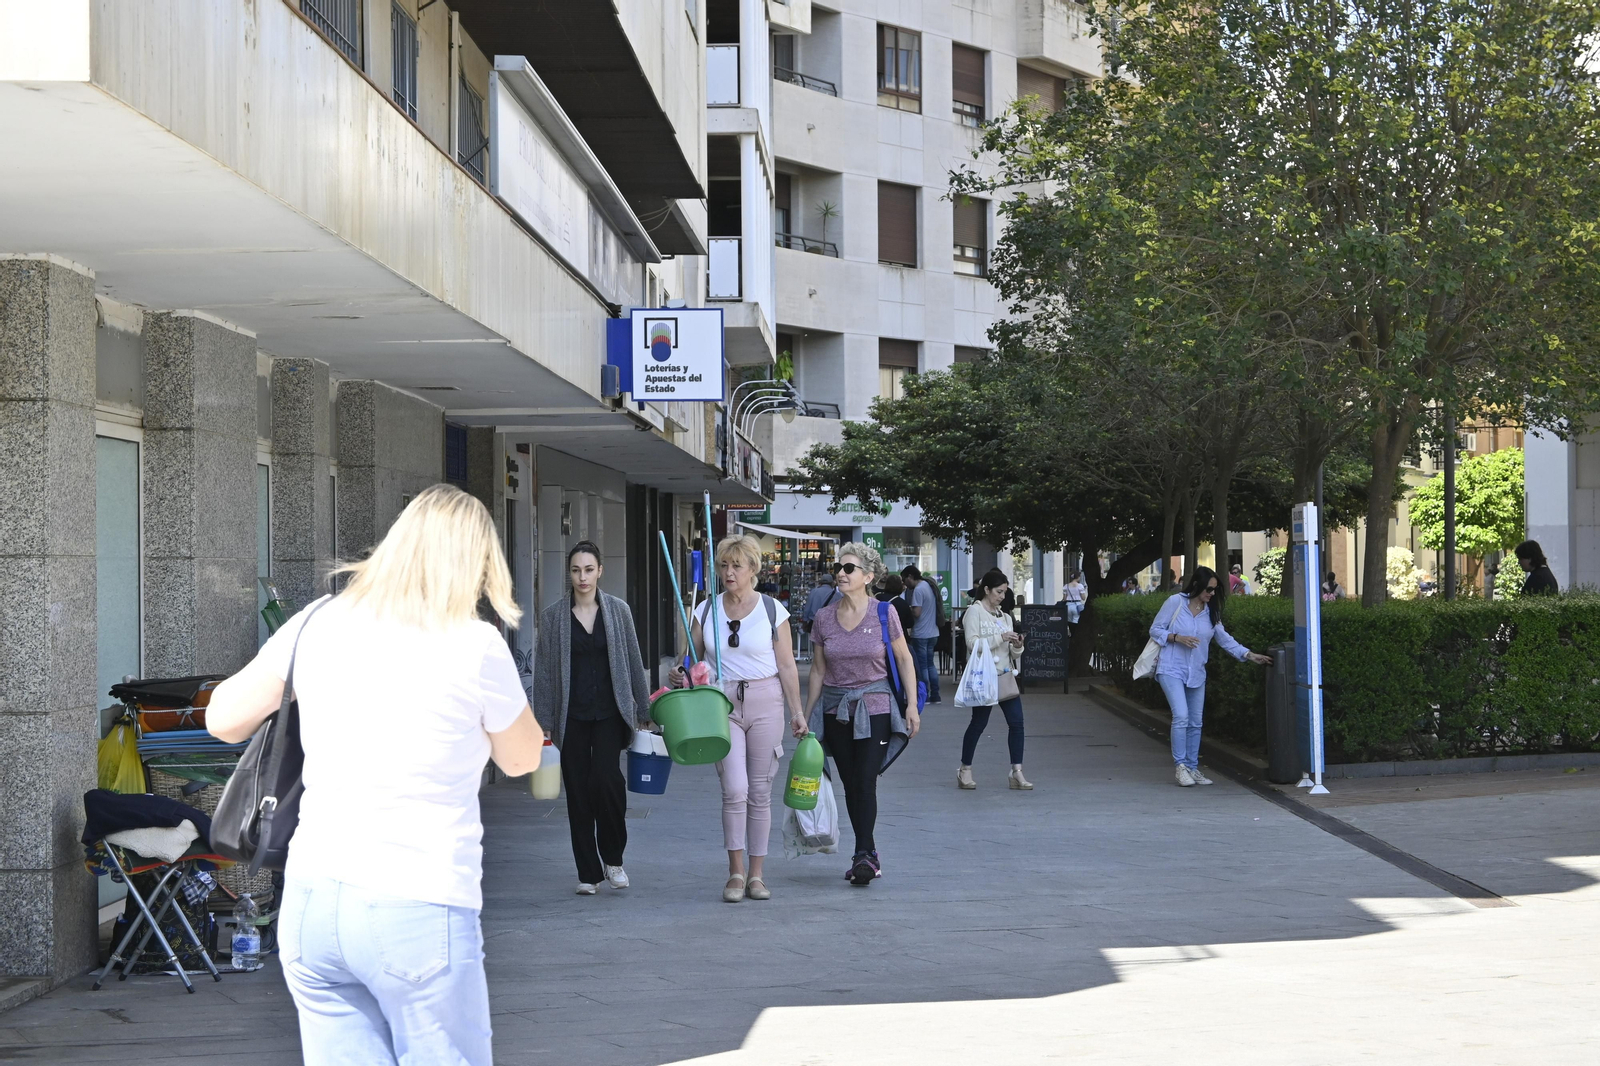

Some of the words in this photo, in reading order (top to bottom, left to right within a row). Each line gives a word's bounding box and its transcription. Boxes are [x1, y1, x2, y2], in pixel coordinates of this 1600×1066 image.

[644, 364, 681, 373] Loterías
[683, 366, 689, 374] y
[645, 374, 686, 384] Apuestas
[688, 374, 702, 383] del
[644, 384, 676, 393] Estado
[852, 514, 874, 524] express
[1027, 641, 1062, 655] GAMBAS
